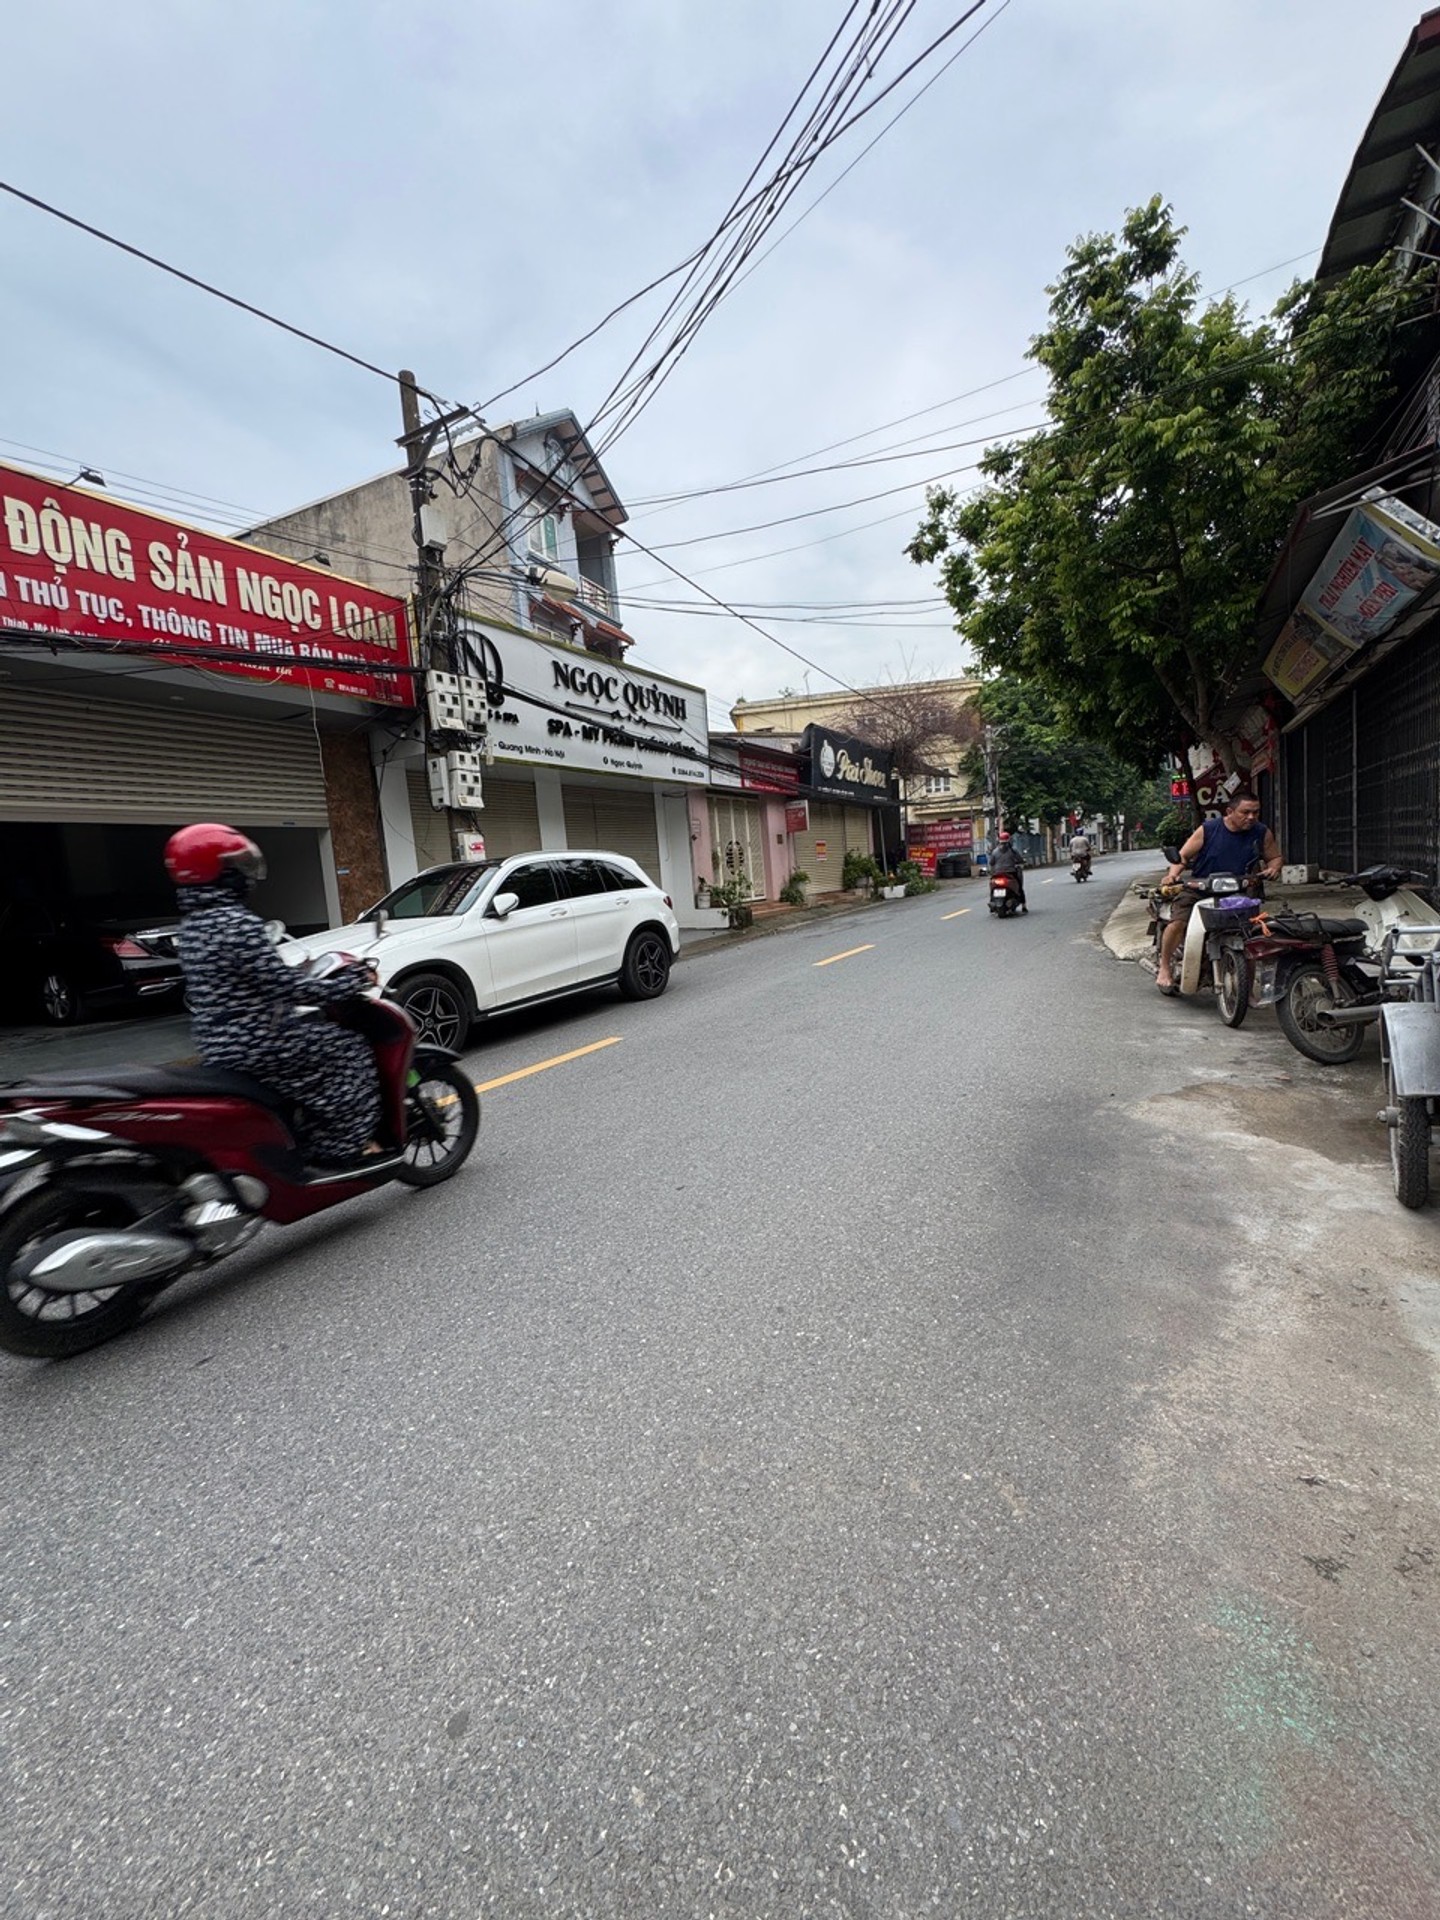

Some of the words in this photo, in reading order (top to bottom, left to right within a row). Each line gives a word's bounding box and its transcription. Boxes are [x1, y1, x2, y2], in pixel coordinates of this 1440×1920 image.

[4, 496, 136, 583] ĐỘNG
[147, 532, 228, 606] SẢN
[236, 565, 323, 633] NGỌC
[329, 595, 398, 651] LOAN
[14, 575, 70, 612] THỦ
[75, 589, 133, 629] TỤC,
[137, 606, 212, 643] THÔNG
[216, 623, 250, 650] TIN
[254, 632, 296, 658] MUA
[552, 660, 619, 705] NGỌC
[622, 683, 688, 722] QUỲNH
[547, 718, 573, 737] SPA
